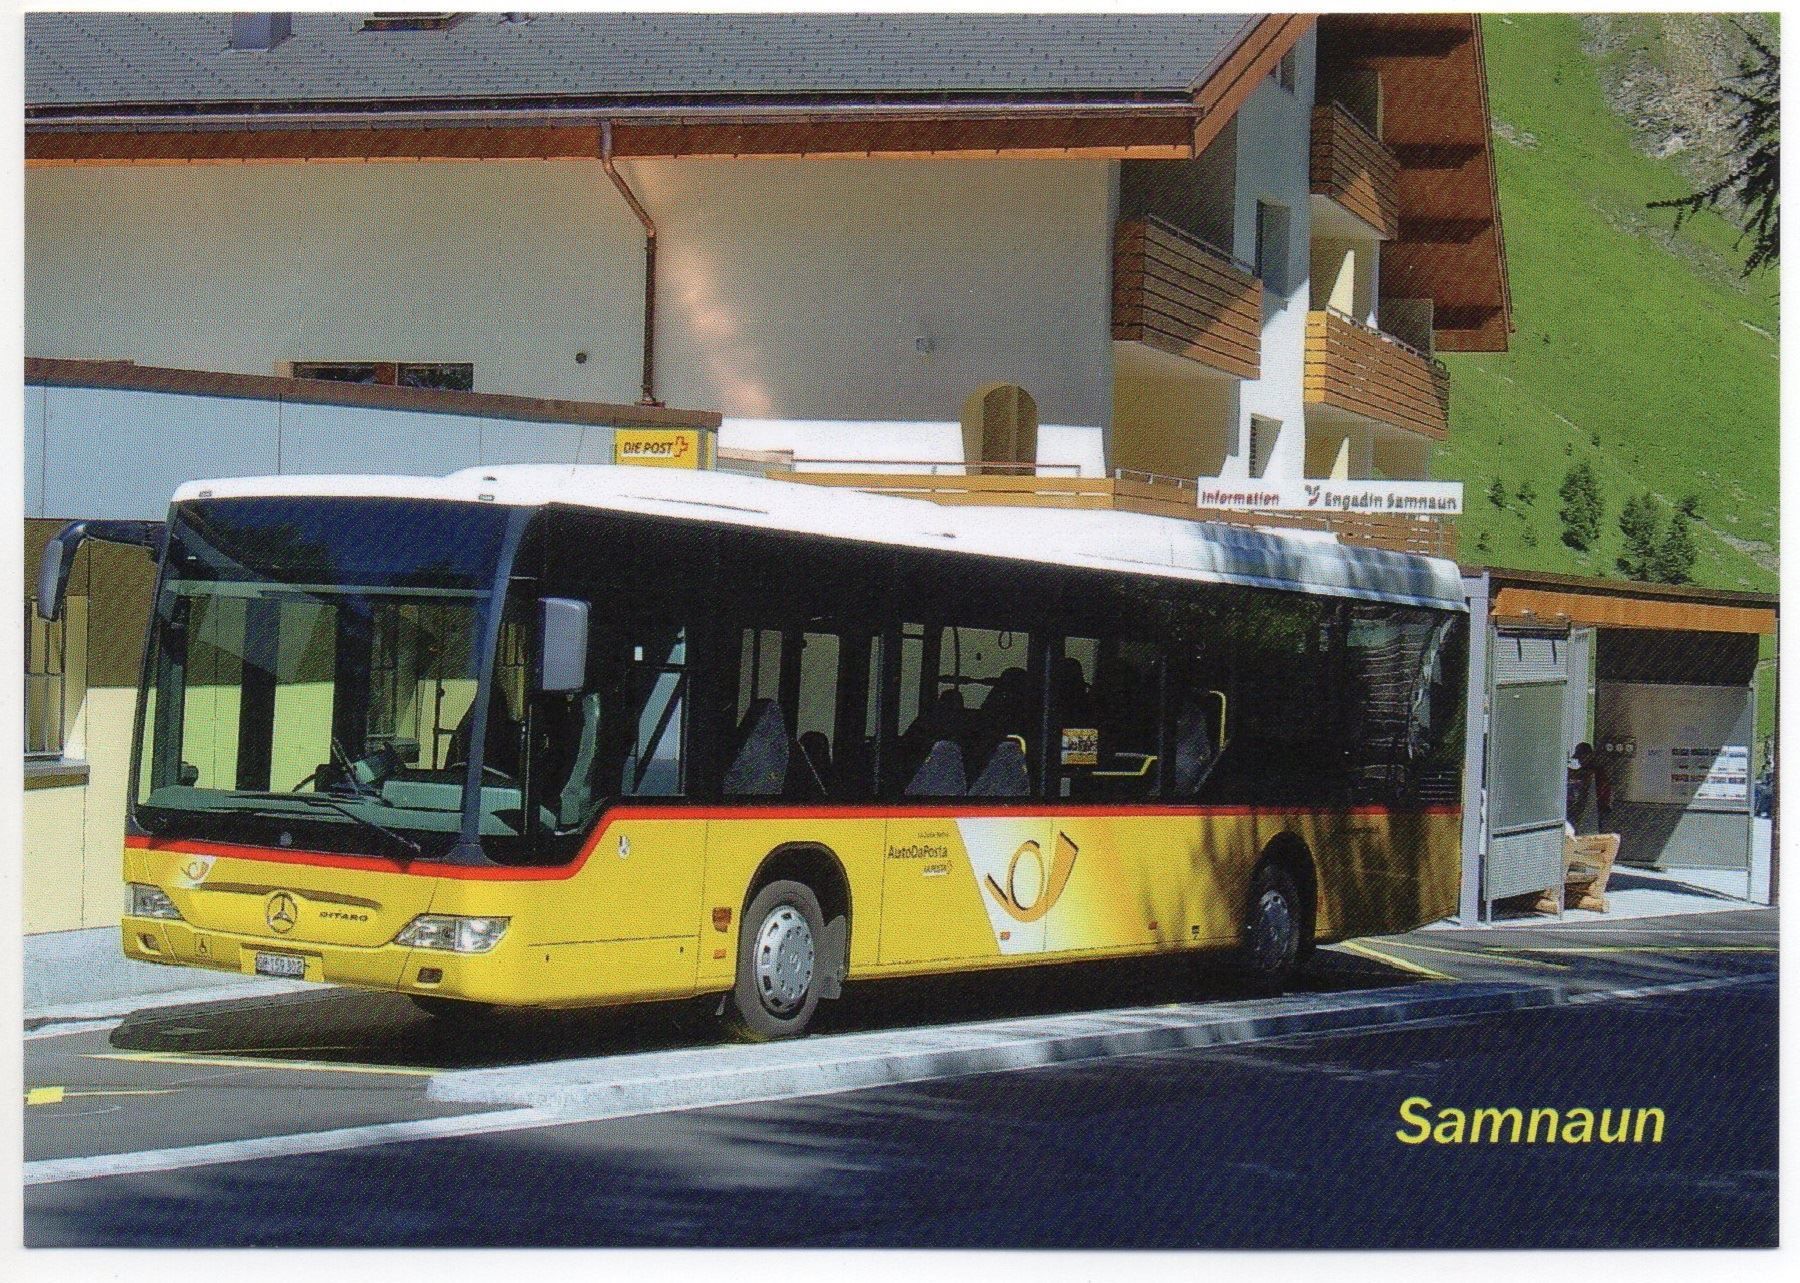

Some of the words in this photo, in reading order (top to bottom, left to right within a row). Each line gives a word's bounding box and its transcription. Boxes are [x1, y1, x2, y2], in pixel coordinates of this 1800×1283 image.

[624, 441, 642, 454] DIE
[643, 441, 674, 454] POST
[1201, 490, 1280, 506] Information
[1324, 491, 1383, 511] Engadin
[1386, 493, 1457, 510] Samnaun
[888, 845, 948, 859] AutoDaPosta
